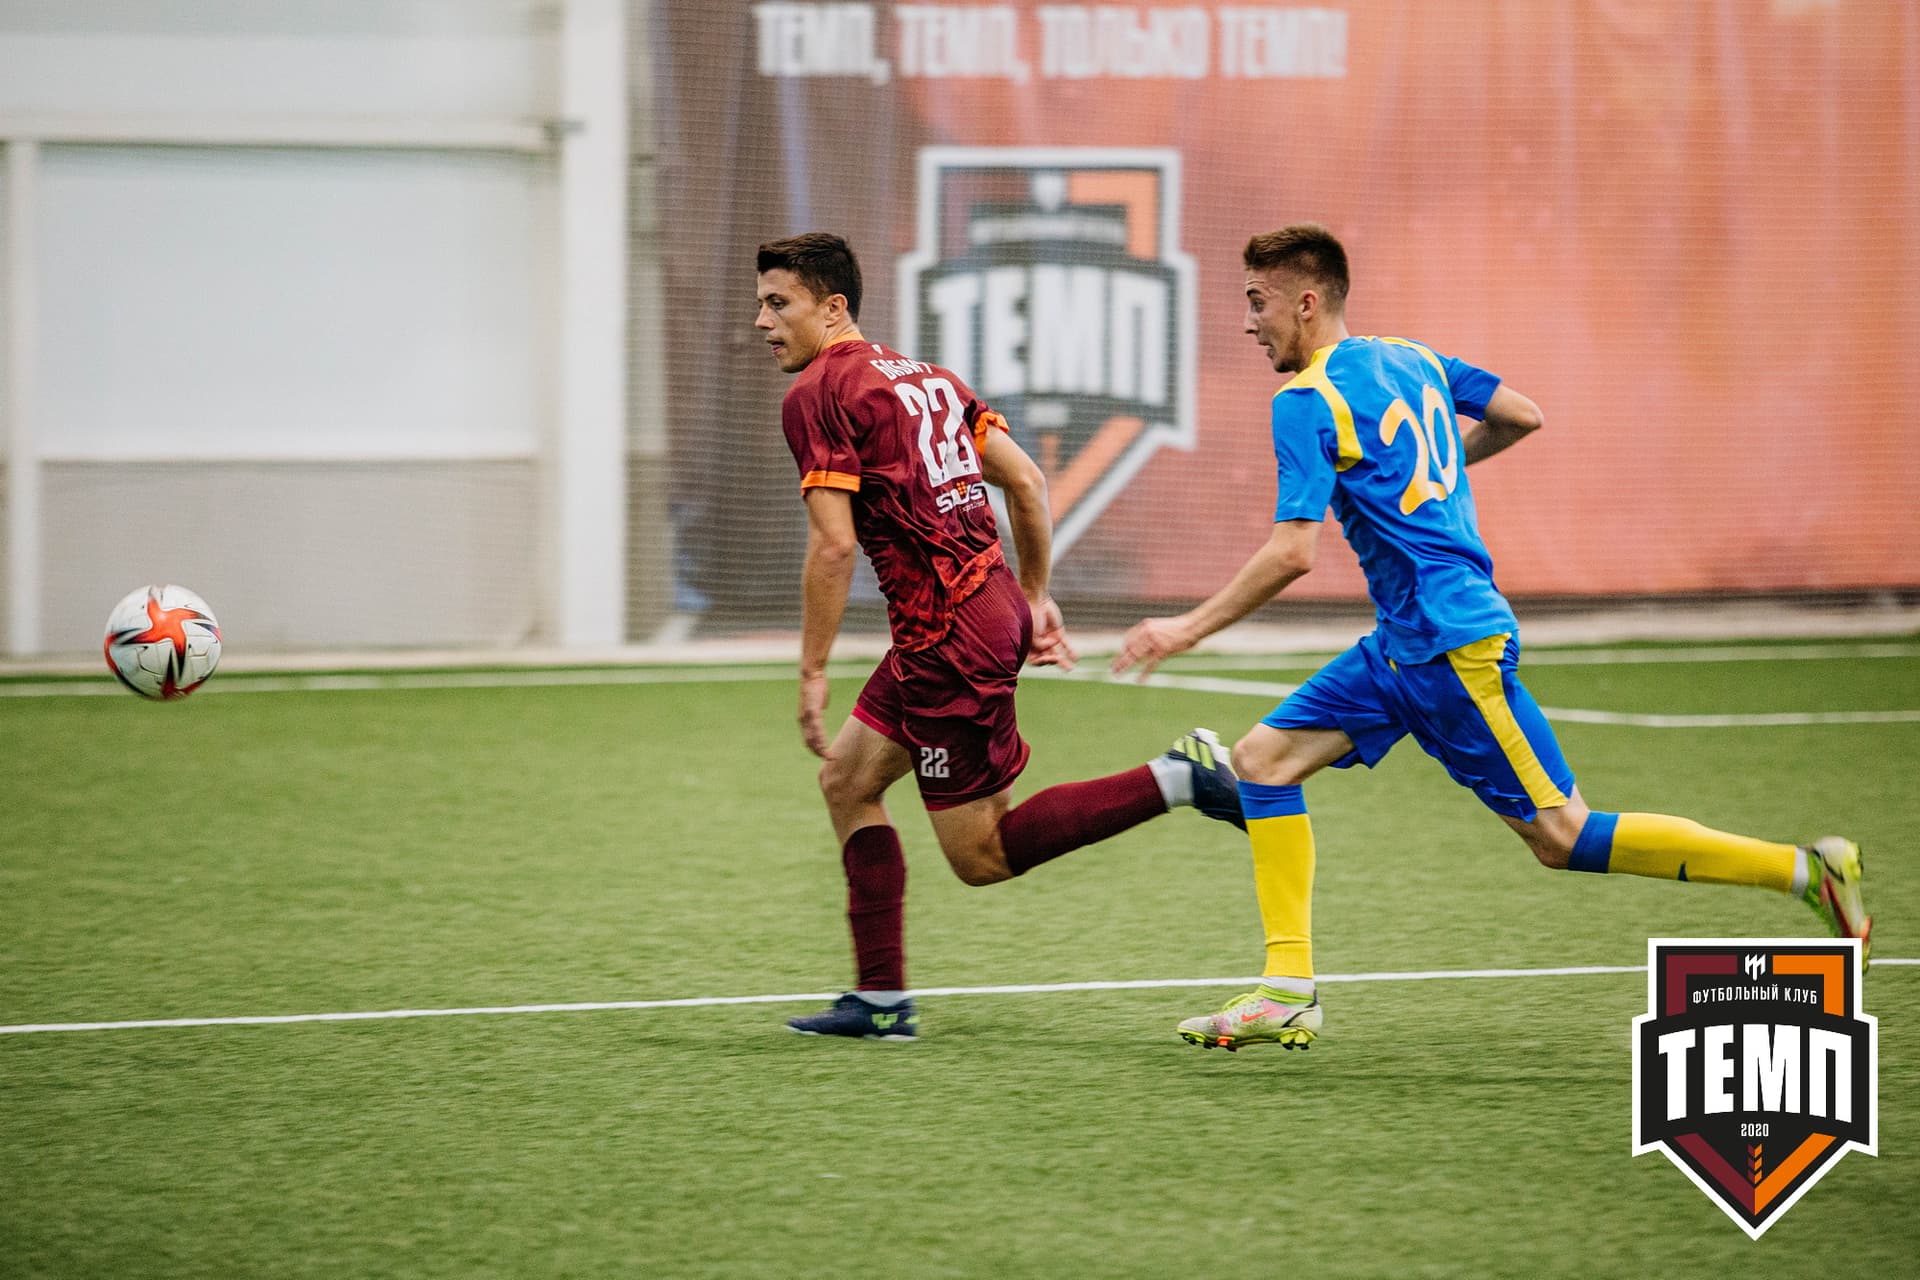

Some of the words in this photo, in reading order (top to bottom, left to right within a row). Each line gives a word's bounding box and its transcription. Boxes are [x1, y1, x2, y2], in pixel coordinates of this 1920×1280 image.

[928, 263, 1168, 404] ТЕМП
[894, 377, 980, 488] 22
[1379, 384, 1458, 516] 20
[920, 746, 951, 778] 22
